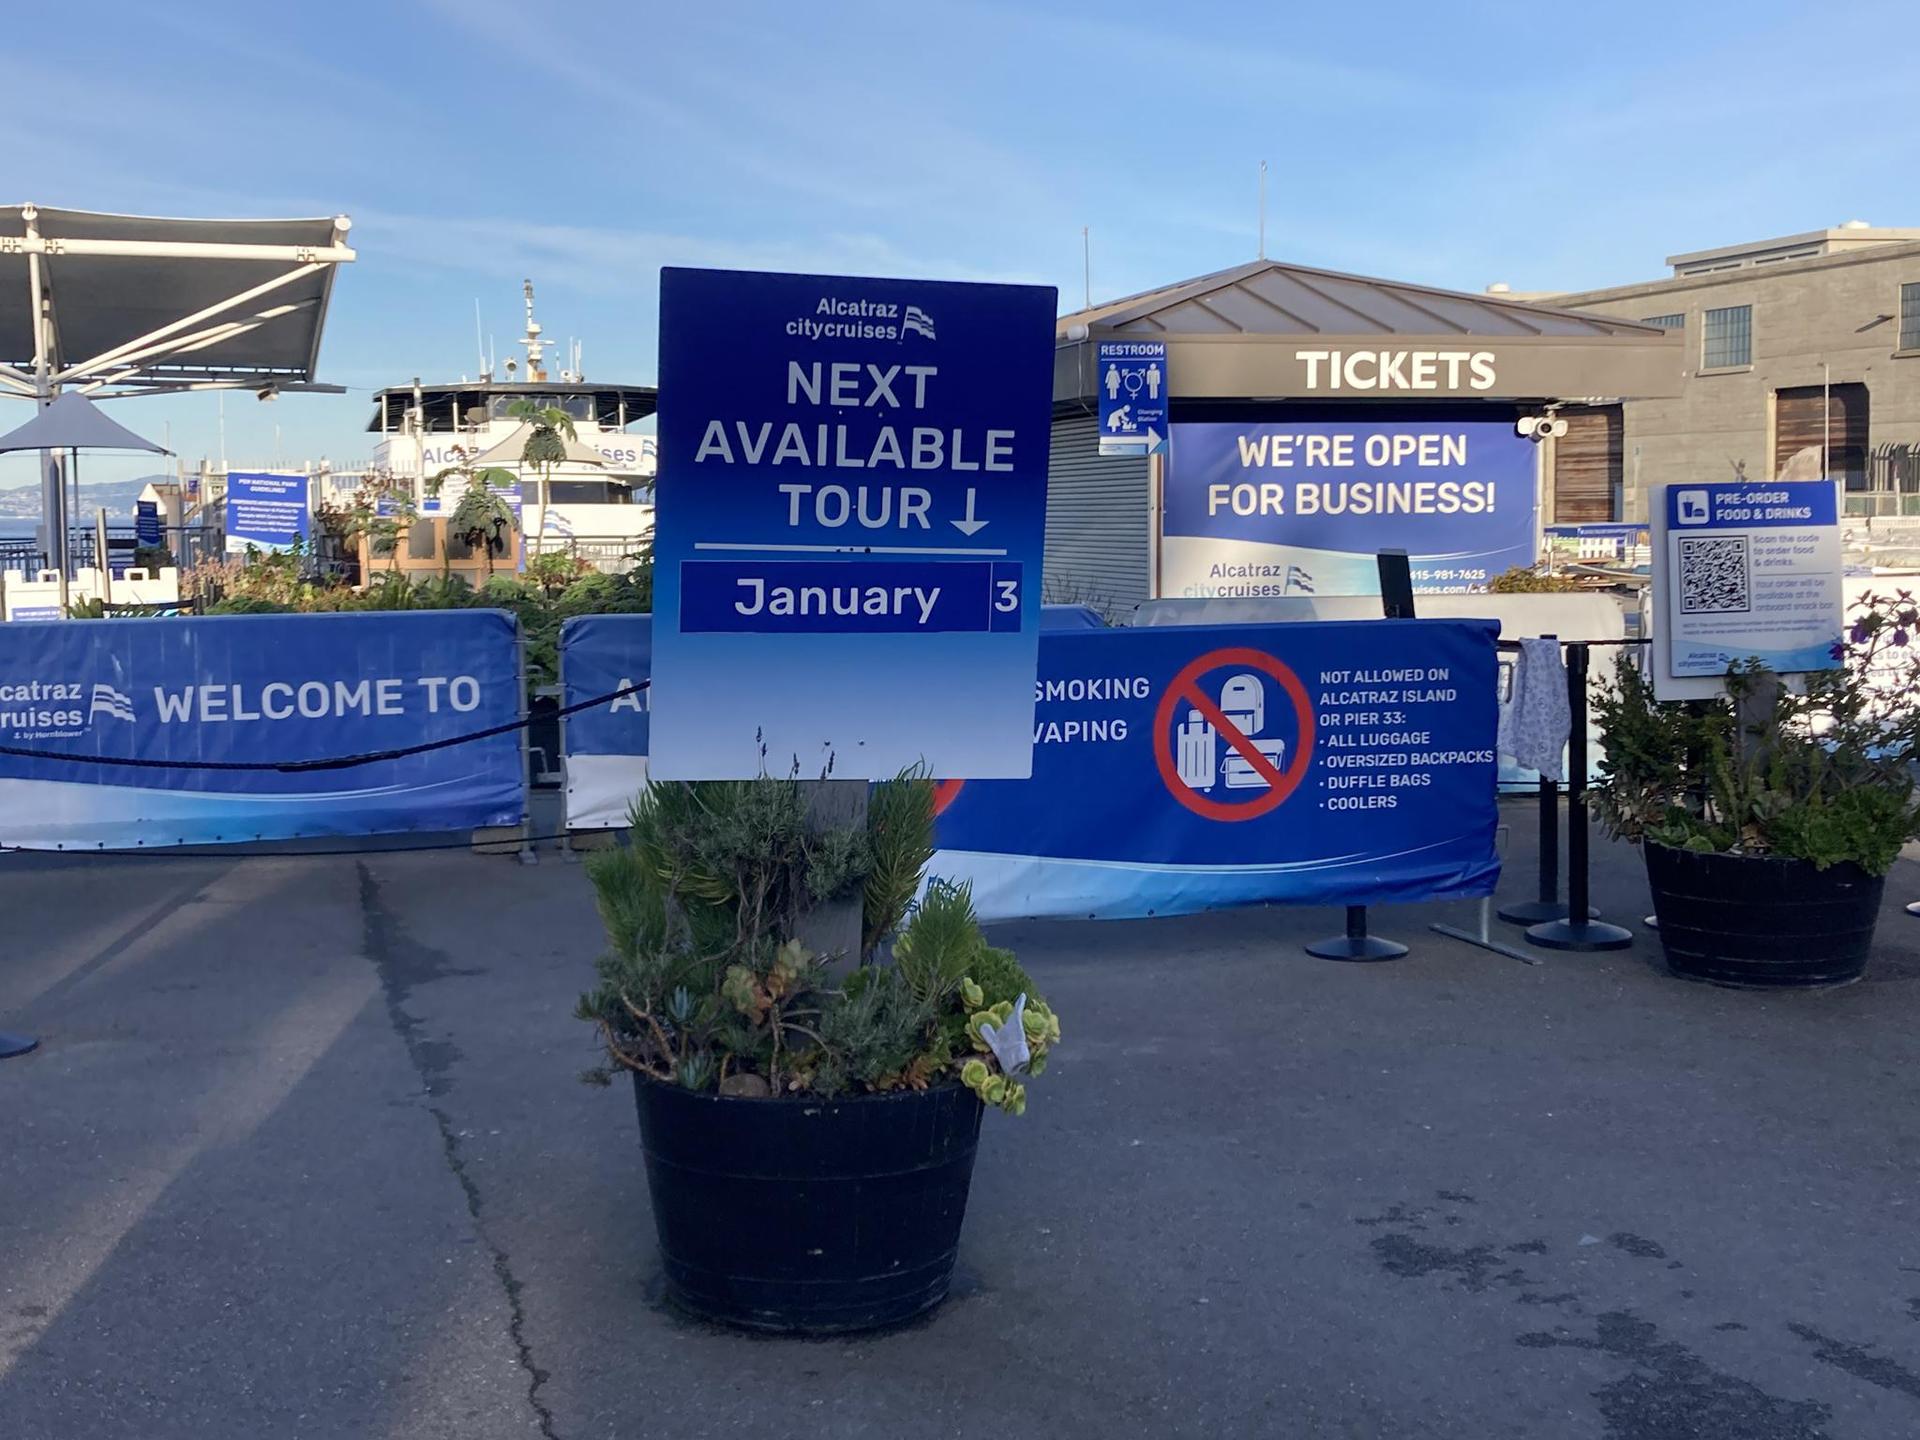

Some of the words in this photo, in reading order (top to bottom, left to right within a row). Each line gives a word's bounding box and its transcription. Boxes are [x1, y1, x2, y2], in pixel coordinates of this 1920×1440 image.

[816, 298, 898, 318] Alcatraz
[786, 318, 898, 340] citycruises
[1101, 345, 1164, 356] RESTROOM
[1295, 351, 1496, 390] TICKETS
[787, 361, 938, 409] NEXT
[695, 420, 1016, 472] AVAILABLE
[1238, 434, 1354, 468] WE'RE
[1364, 434, 1467, 467] OPEN
[779, 484, 933, 530] TOUR
[1209, 484, 1284, 516] FOR
[1295, 482, 1496, 515] BUSINESS!
[1716, 492, 1789, 505] PRE-ORDER
[1716, 508, 1750, 521] FOOD
[1753, 508, 1763, 520] &
[1765, 507, 1812, 520] DRINKS
[1209, 562, 1280, 577] Alcatraz
[1183, 582, 1280, 597] citycruises
[734, 578, 941, 624] January
[995, 580, 1018, 612] 3
[1320, 671, 1351, 684] NOT
[1353, 668, 1424, 683] ALLOWED
[1428, 668, 1449, 681] ON
[154, 679, 404, 723] WELCOME
[418, 676, 481, 713] TO
[610, 678, 650, 713] A
[1319, 690, 1399, 705] ALCATRAZ
[1402, 689, 1457, 703] ISLAND
[1319, 713, 1340, 726] OR
[1344, 712, 1379, 725] PIER
[1382, 711, 1407, 725] 33:
[23, 732, 34, 740] by
[1328, 734, 1356, 747] ALL
[1360, 732, 1430, 746] LUGGAGE
[1327, 754, 1408, 768] OVERSIZED
[1410, 750, 1494, 765] BACKPACKS
[1328, 775, 1386, 789] DUFFLE
[1390, 773, 1431, 787] BAGS
[1328, 795, 1398, 810] COOLERS
